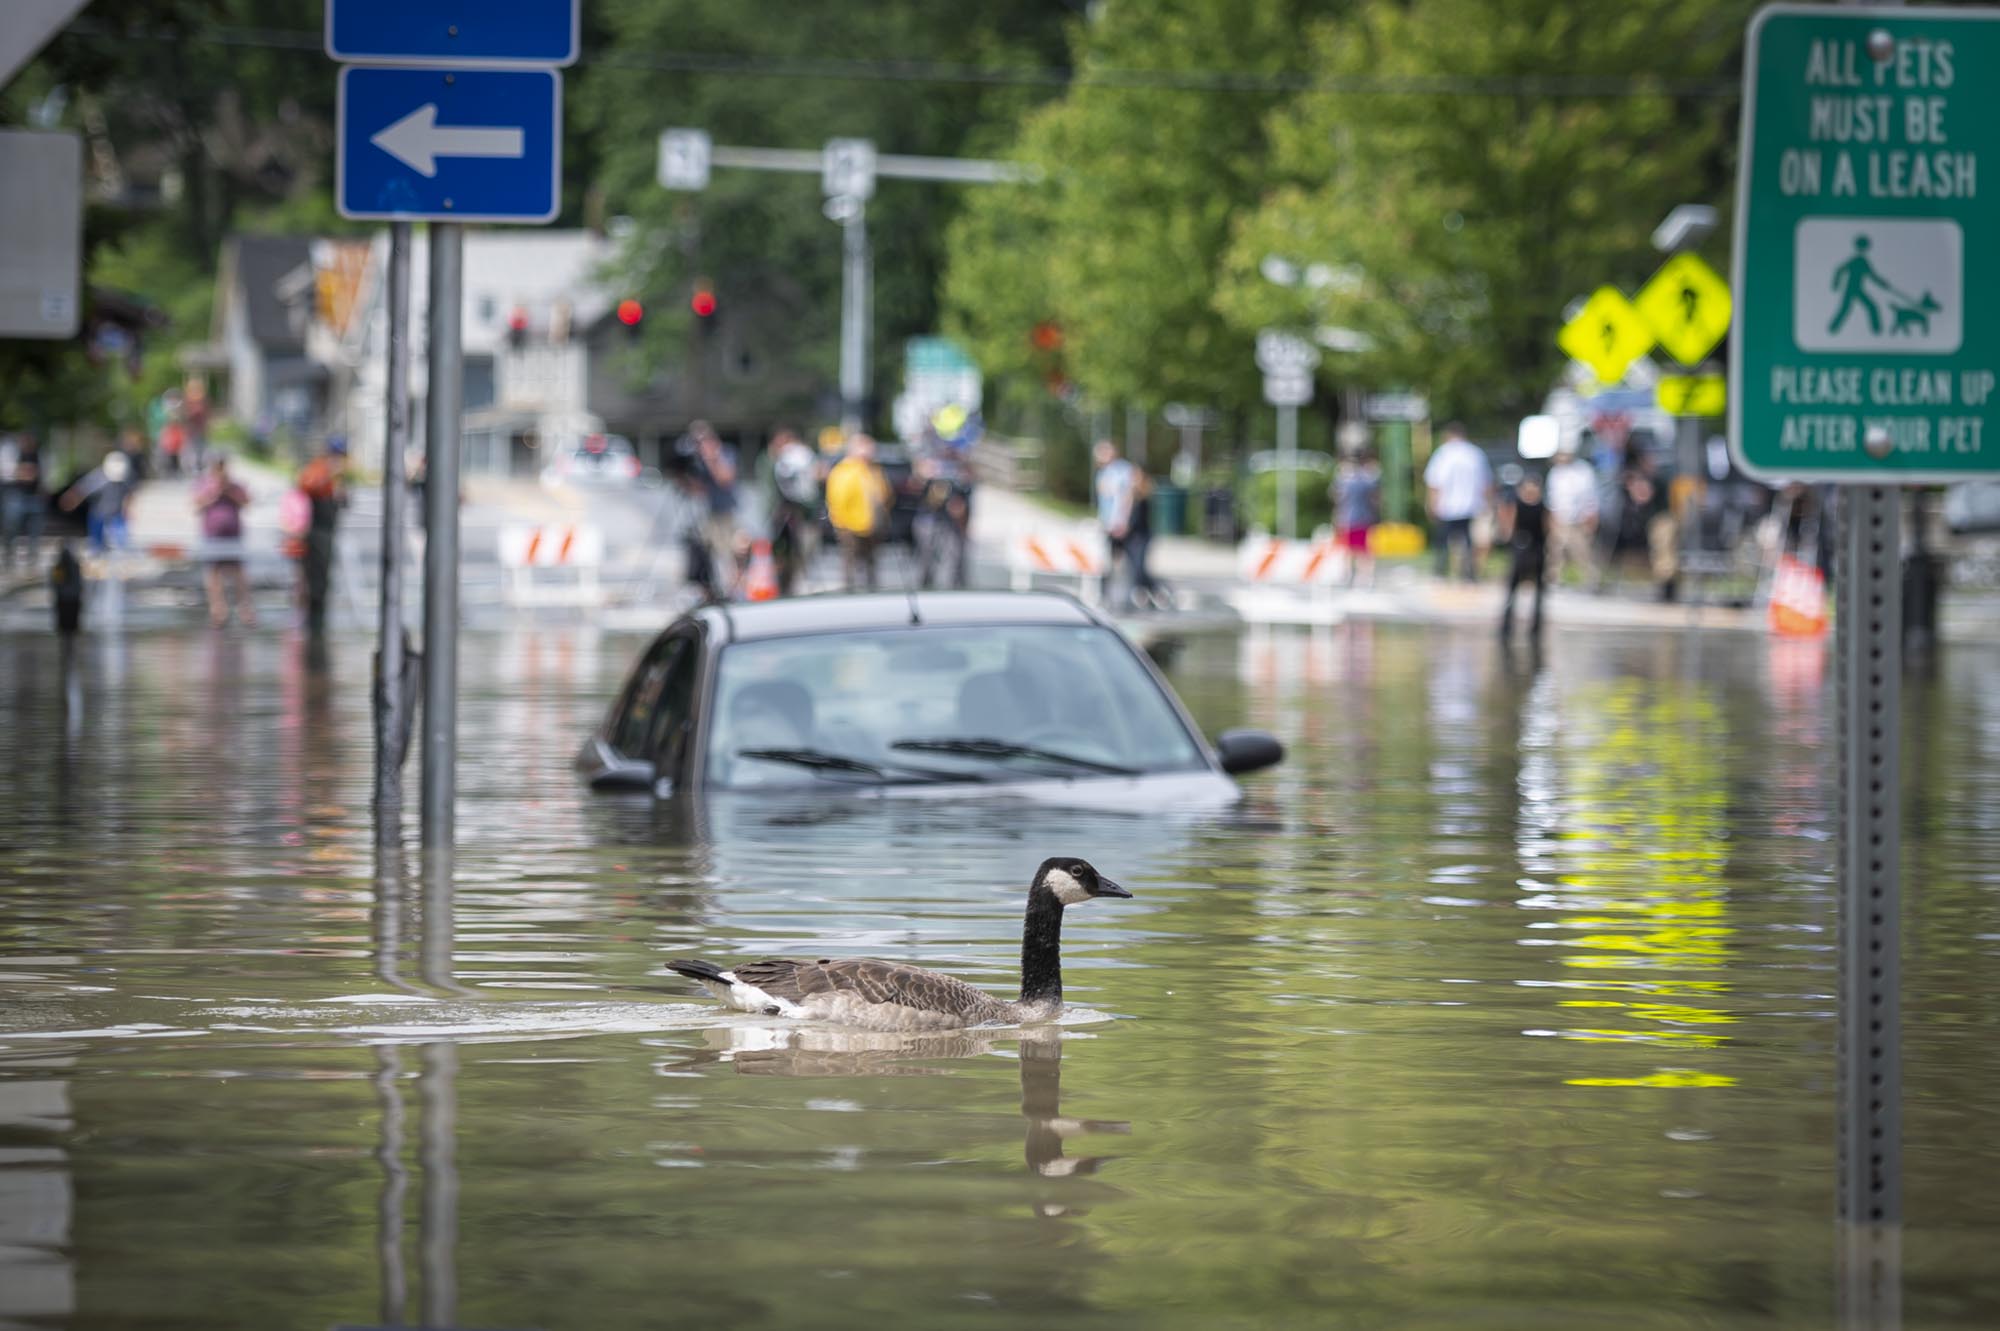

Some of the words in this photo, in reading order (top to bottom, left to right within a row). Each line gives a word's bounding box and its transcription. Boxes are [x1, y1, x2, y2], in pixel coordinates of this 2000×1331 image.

[1805, 38, 1861, 86] ALL
[1873, 40, 1955, 88] PETS
[1810, 95, 1893, 143] MUST
[1905, 96, 1948, 144] BE
[1780, 148, 1822, 196] ON
[1832, 151, 1857, 197] A
[1869, 151, 1977, 199] LEASH
[1770, 366, 1863, 405] PLEASE
[1869, 368, 1952, 406] CLEAN
[1960, 369, 1995, 406] UP
[1780, 414, 1857, 451] AFTER
[1938, 416, 1984, 453] PET
